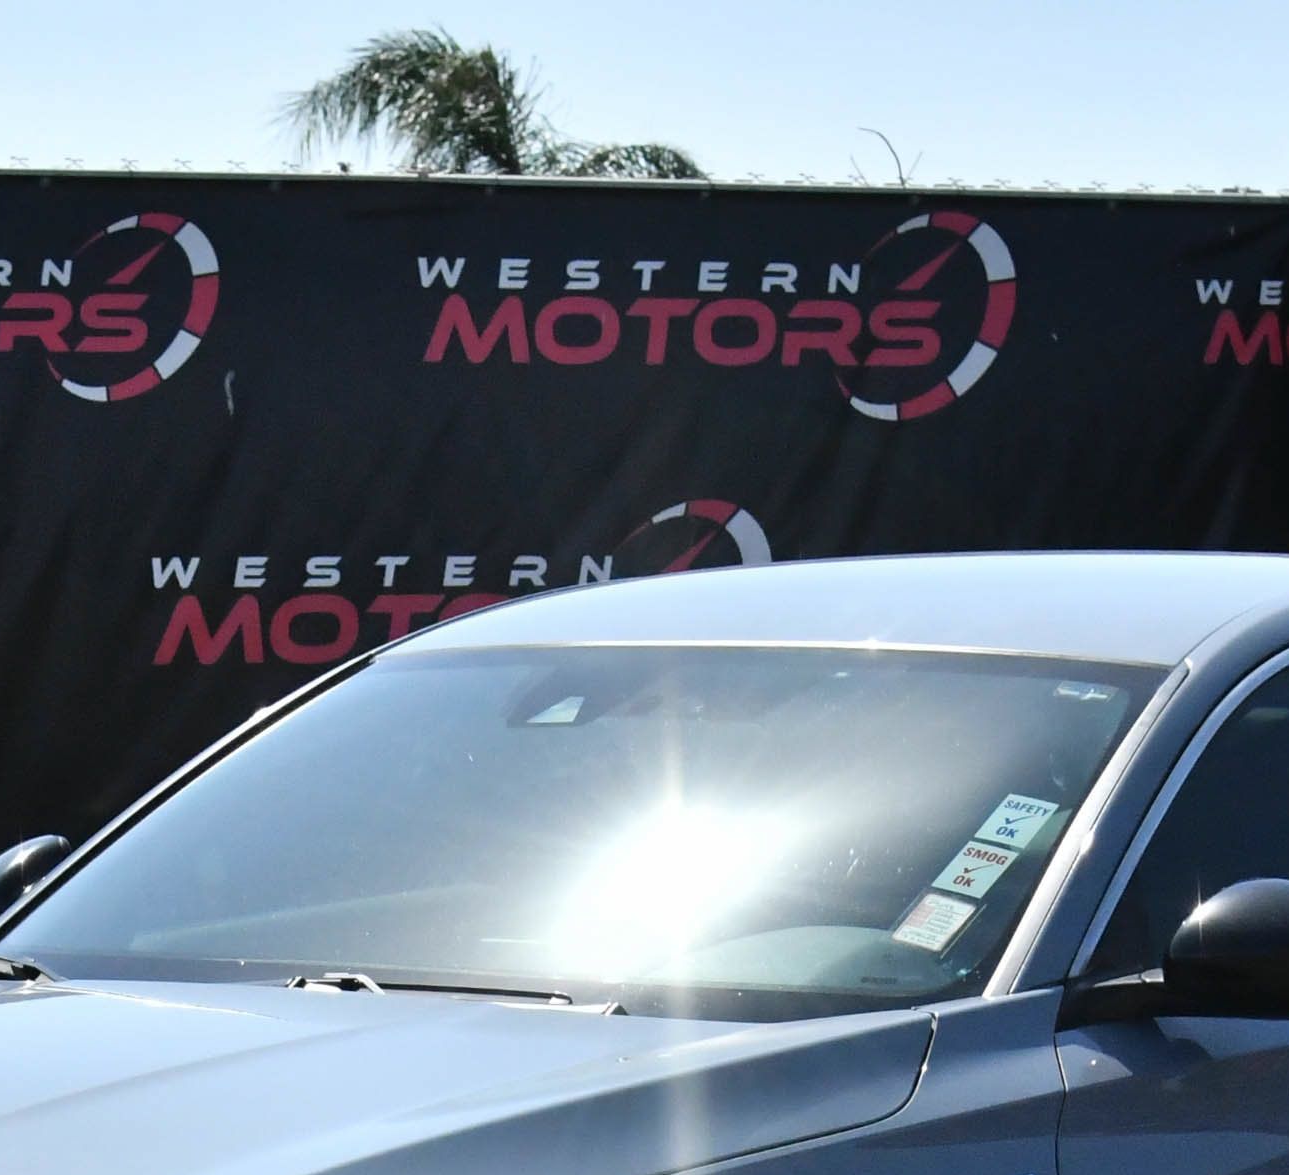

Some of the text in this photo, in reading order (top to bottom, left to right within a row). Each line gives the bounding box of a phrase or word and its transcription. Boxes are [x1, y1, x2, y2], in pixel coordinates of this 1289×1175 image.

[416, 256, 862, 293] WESTERN
[423, 295, 943, 367] MOTORS
[152, 554, 614, 588] WESTERN
[153, 594, 509, 665] MOT
[1004, 800, 1052, 817] SAFETY
[996, 826, 1018, 839] OK
[963, 847, 1008, 866] SMOG
[953, 875, 975, 888] OK
